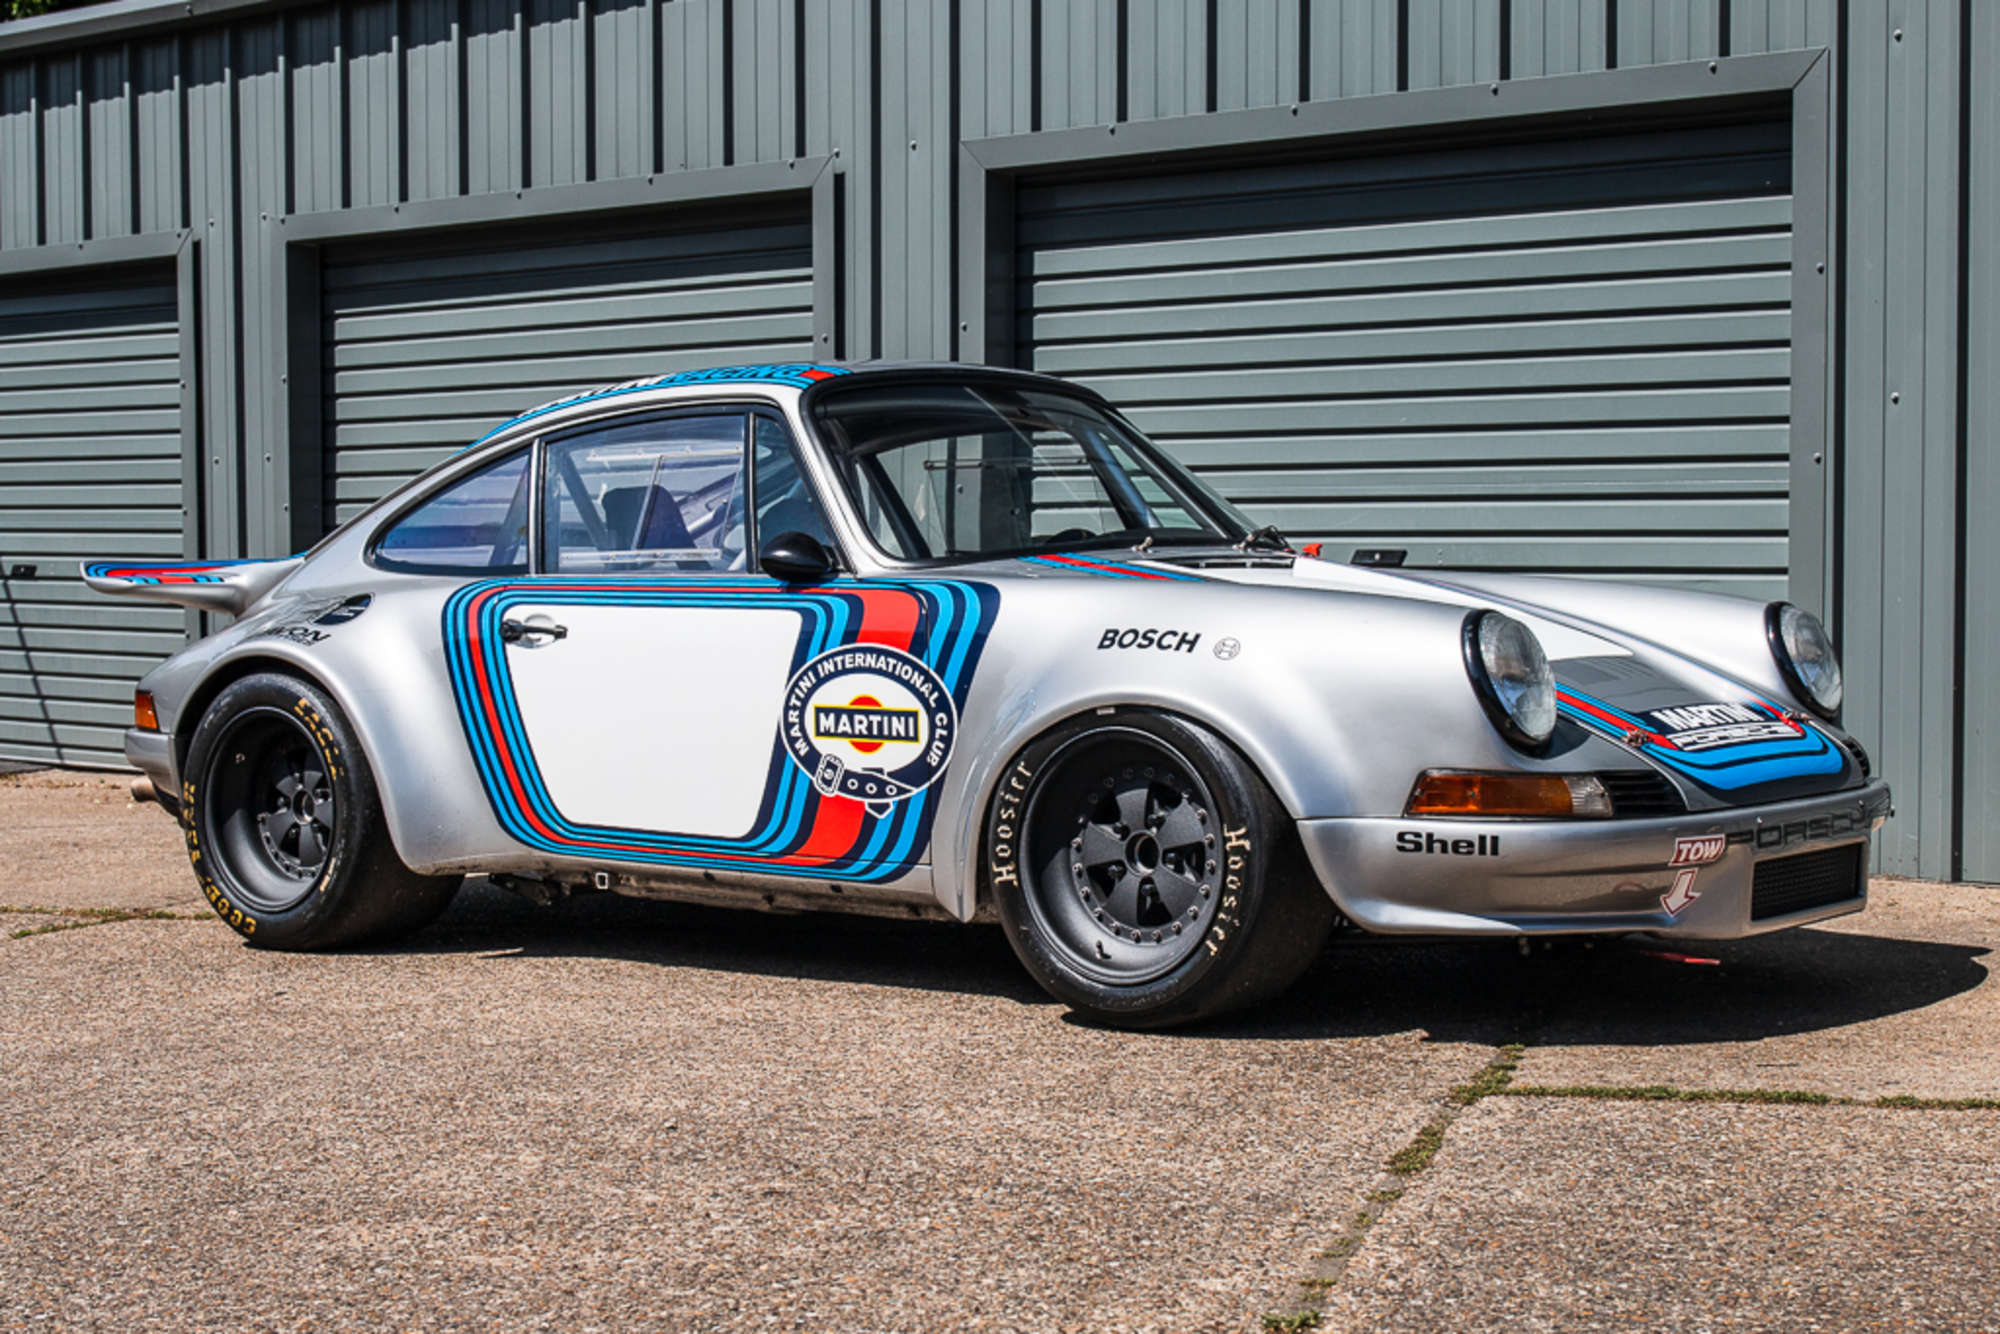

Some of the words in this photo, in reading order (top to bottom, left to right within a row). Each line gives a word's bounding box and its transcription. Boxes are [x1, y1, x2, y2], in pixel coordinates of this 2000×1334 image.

[1097, 628, 1201, 653] BOSCH
[788, 671, 818, 757] MARTINI
[816, 652, 940, 709] INTERNATIONAL
[926, 712, 948, 767] CLUB
[1650, 702, 1765, 732] MARTINI
[818, 712, 915, 737] MARTINI
[991, 760, 1032, 888] Hoosier
[1396, 831, 1499, 856] Shell
[1678, 840, 1722, 862] TOW
[1204, 824, 1251, 956] Hoosier
